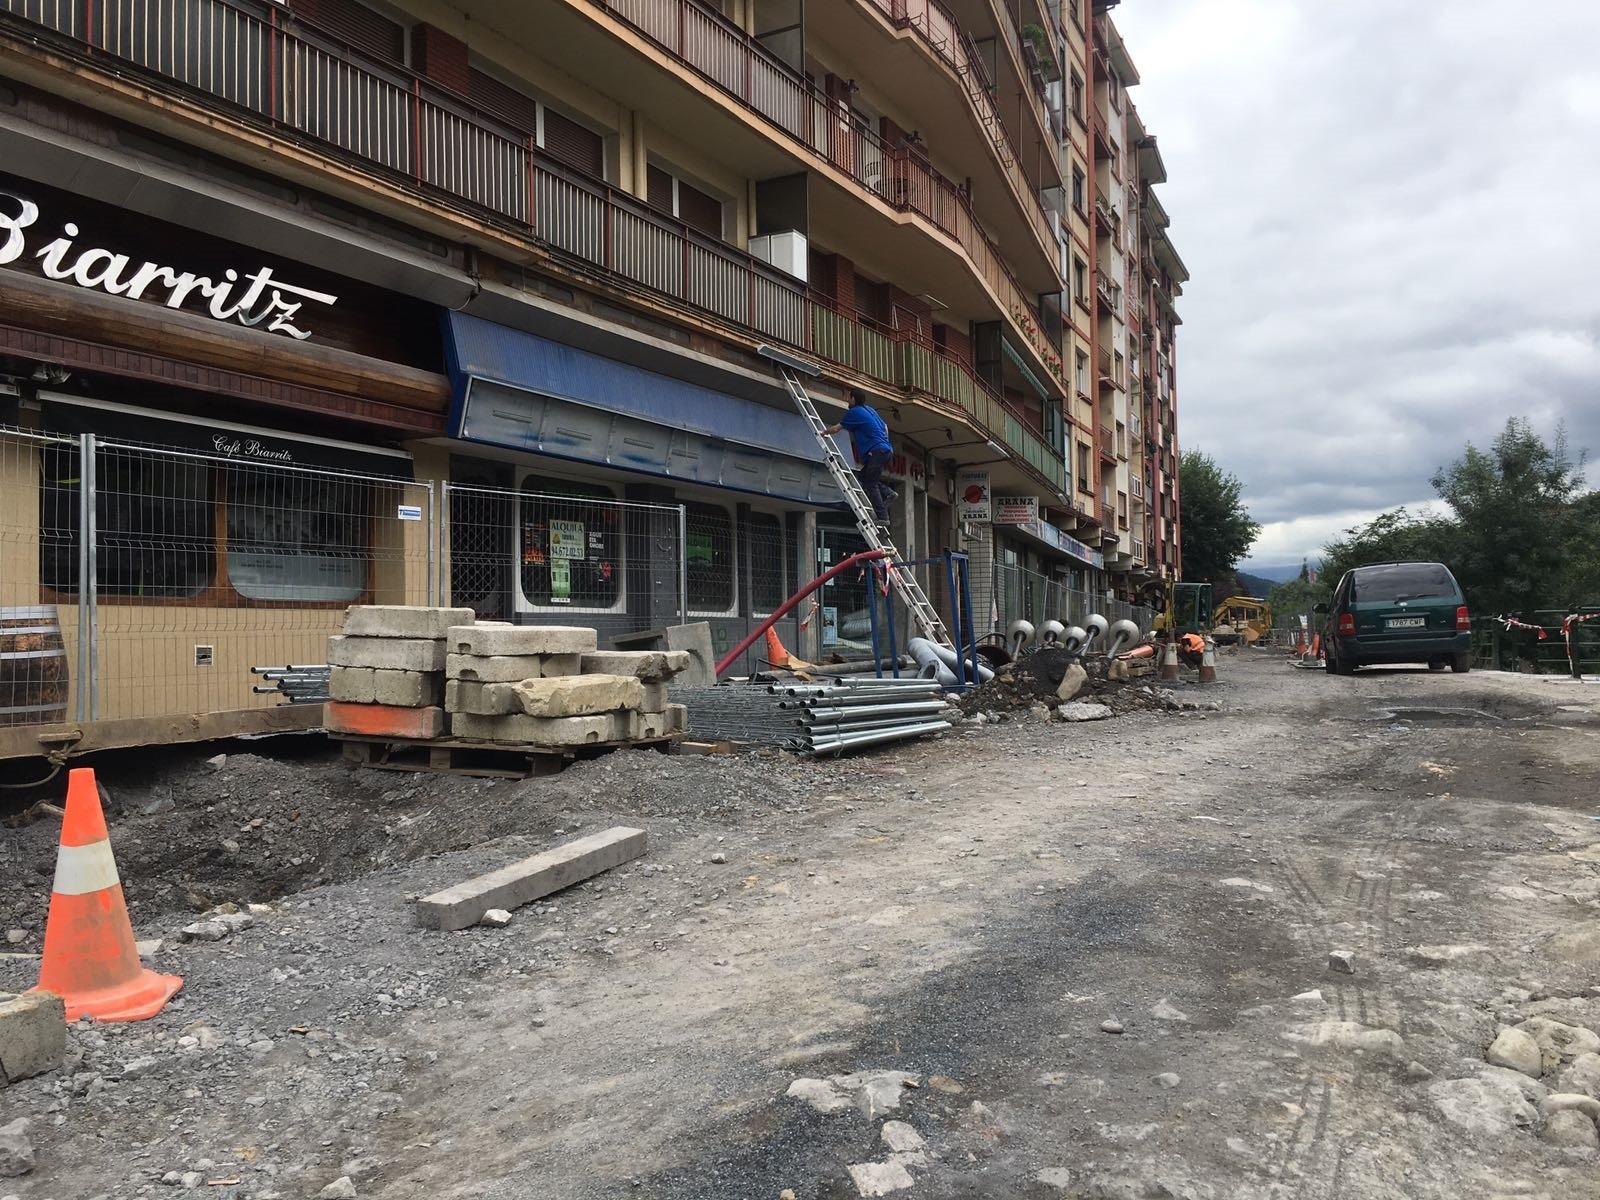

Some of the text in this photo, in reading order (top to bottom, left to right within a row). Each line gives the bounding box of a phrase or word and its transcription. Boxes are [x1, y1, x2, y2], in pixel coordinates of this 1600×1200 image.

[212, 434, 292, 461] Café Biarritz
[998, 497, 1034, 506] ARANA
[551, 521, 583, 533] ALQUILA
